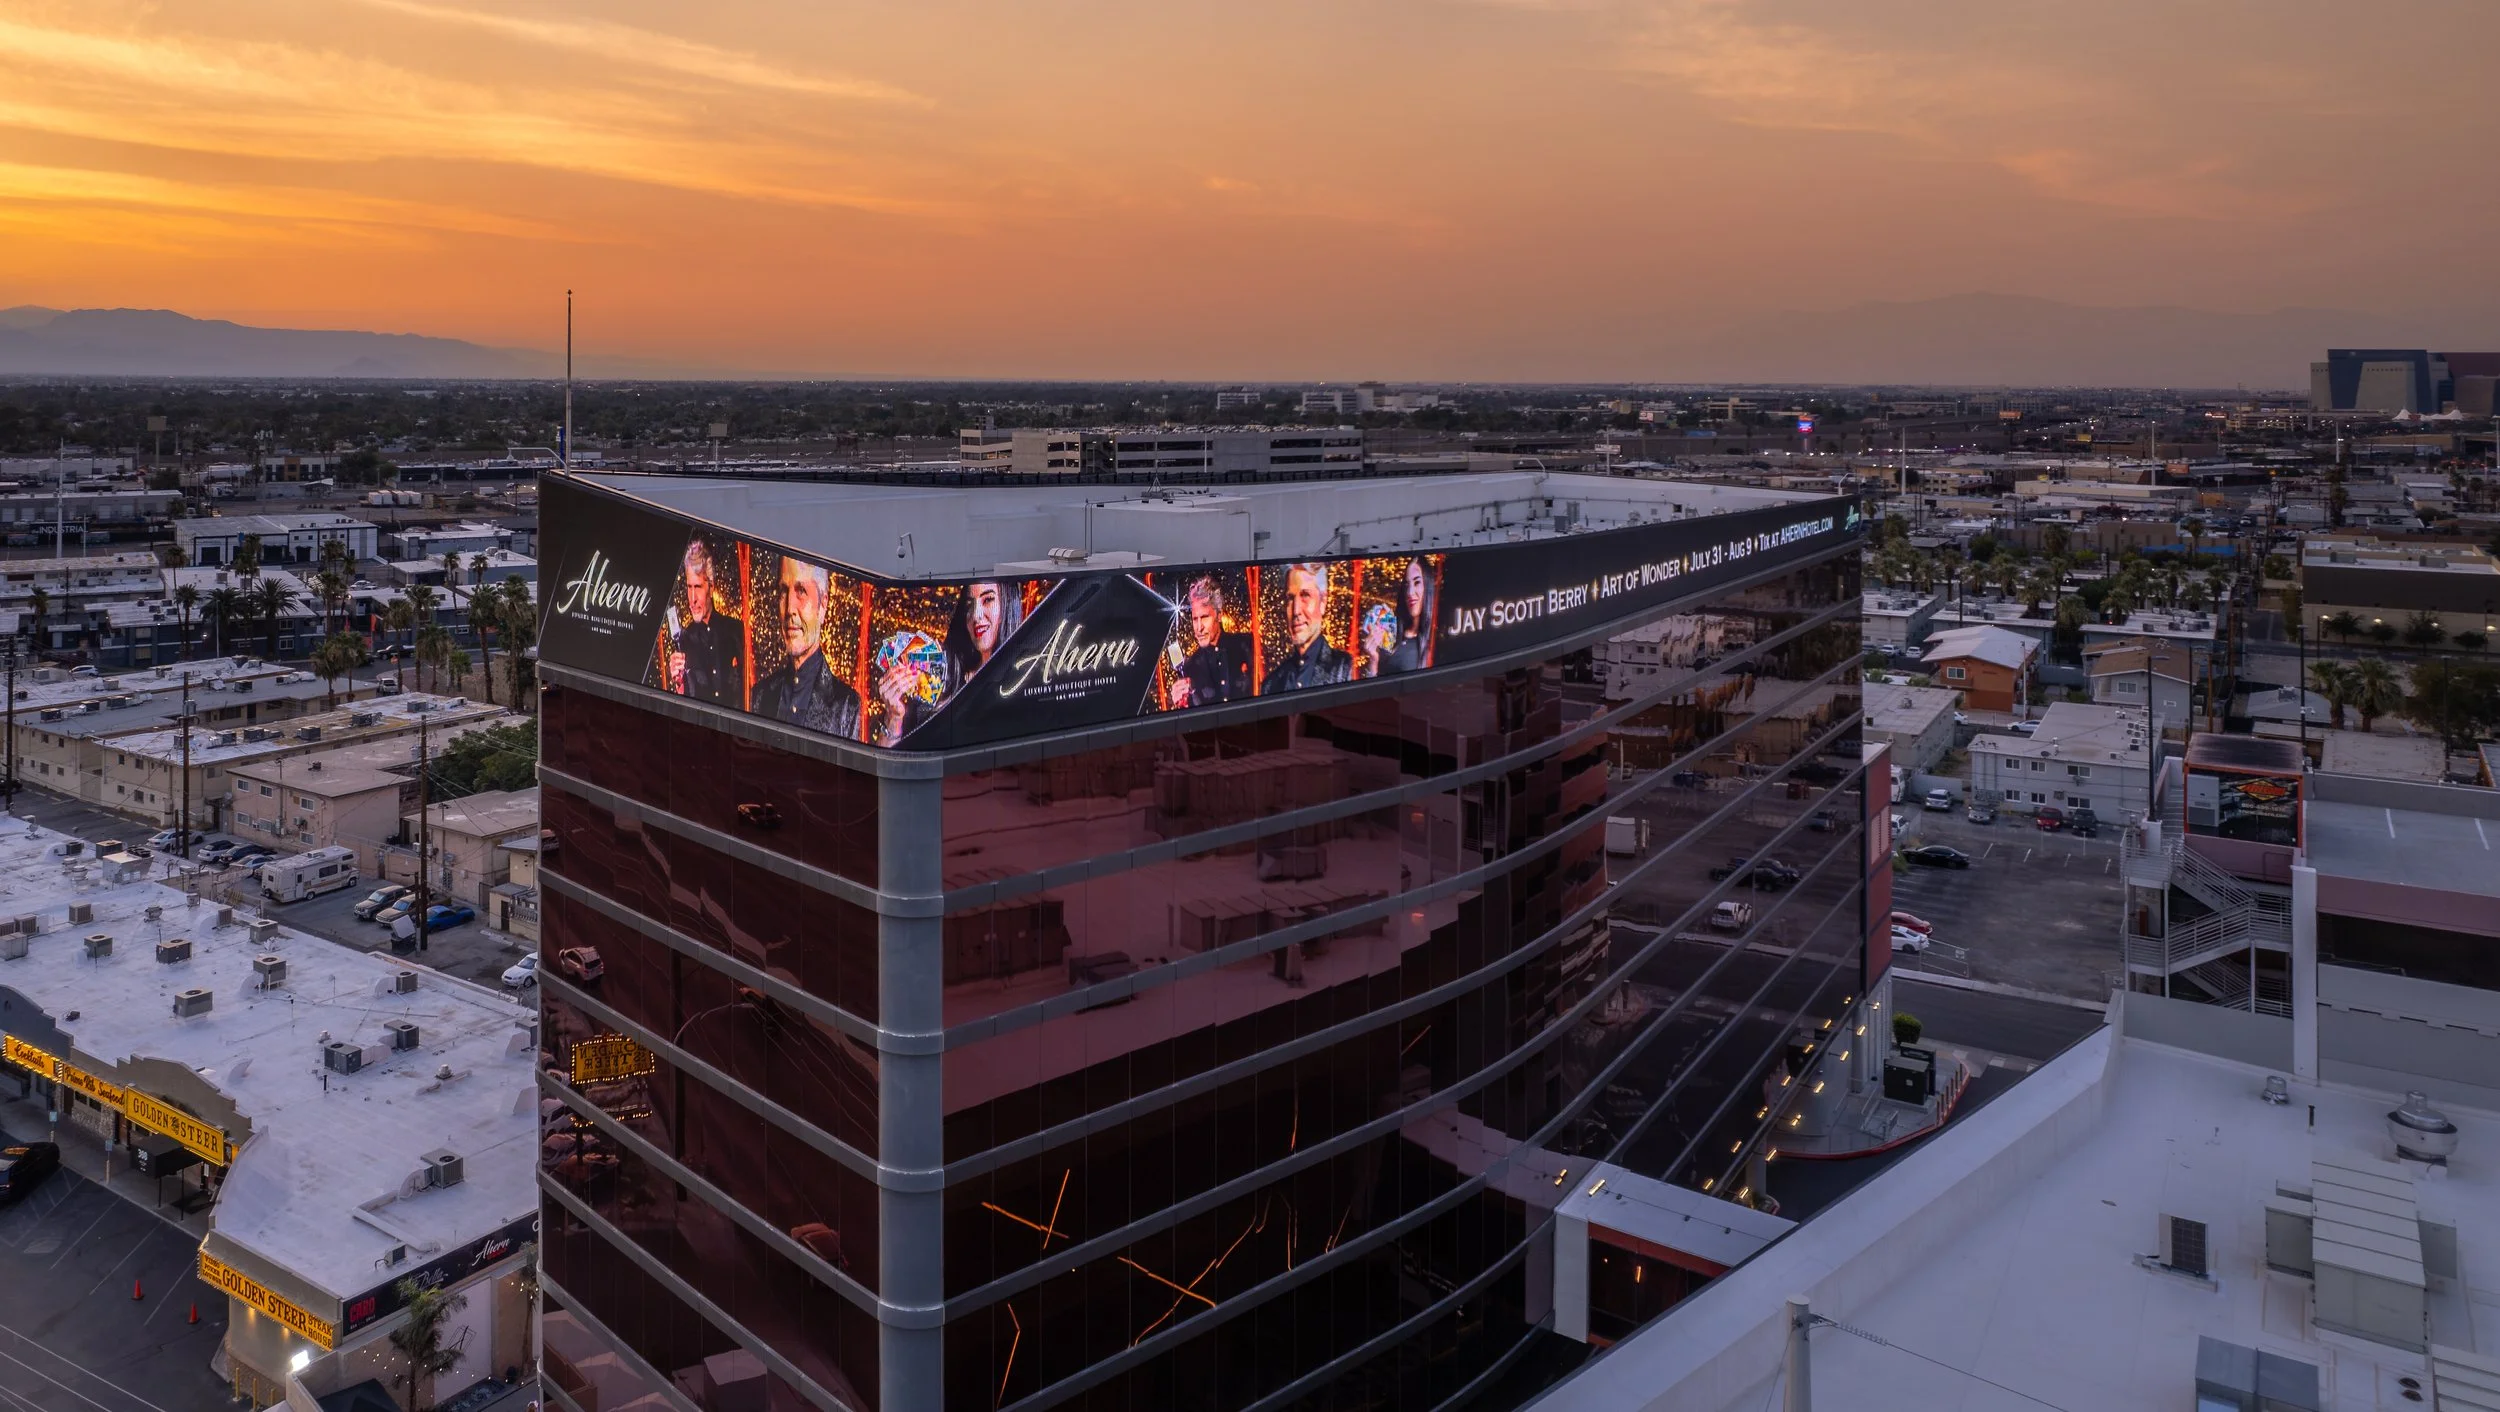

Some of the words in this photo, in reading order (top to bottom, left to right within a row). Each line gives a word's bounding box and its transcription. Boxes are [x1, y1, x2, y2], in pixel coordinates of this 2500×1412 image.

[556, 549, 652, 614] Ahern
[1448, 607, 1486, 635] JAY
[1490, 595, 1544, 627] SCOTT
[1548, 584, 1588, 614] BERRY
[1601, 575, 1623, 599] ART
[1625, 570, 1639, 591] OF
[1641, 559, 1680, 586] WONDER
[1690, 550, 1711, 572] JULY
[1712, 545, 1722, 564] 31
[1729, 541, 1745, 560] AUG
[1746, 538, 1752, 554] 9
[1759, 533, 1770, 551] TIX
[1771, 531, 1779, 547] AT
[1780, 516, 1833, 545] AHERNHOTEL.COM
[1000, 618, 1140, 697] Ahern
[1024, 685, 1052, 697] LUXURY
[1055, 679, 1091, 692] BOUTIQUE
[1095, 675, 1117, 686] HOTEL
[15, 1044, 45, 1068] Cocktails
[65, 1067, 83, 1086] Prime
[84, 1075, 96, 1091] Rib
[98, 1082, 125, 1105] Seafood
[133, 1098, 169, 1129] GOLDEN
[181, 1121, 218, 1153] STEER
[472, 1238, 510, 1266] Ahern
[222, 1268, 266, 1307] GOLDEN
[267, 1295, 307, 1332] STEER
[307, 1328, 333, 1349] HOUSE
[308, 1314, 333, 1337] STEAK
